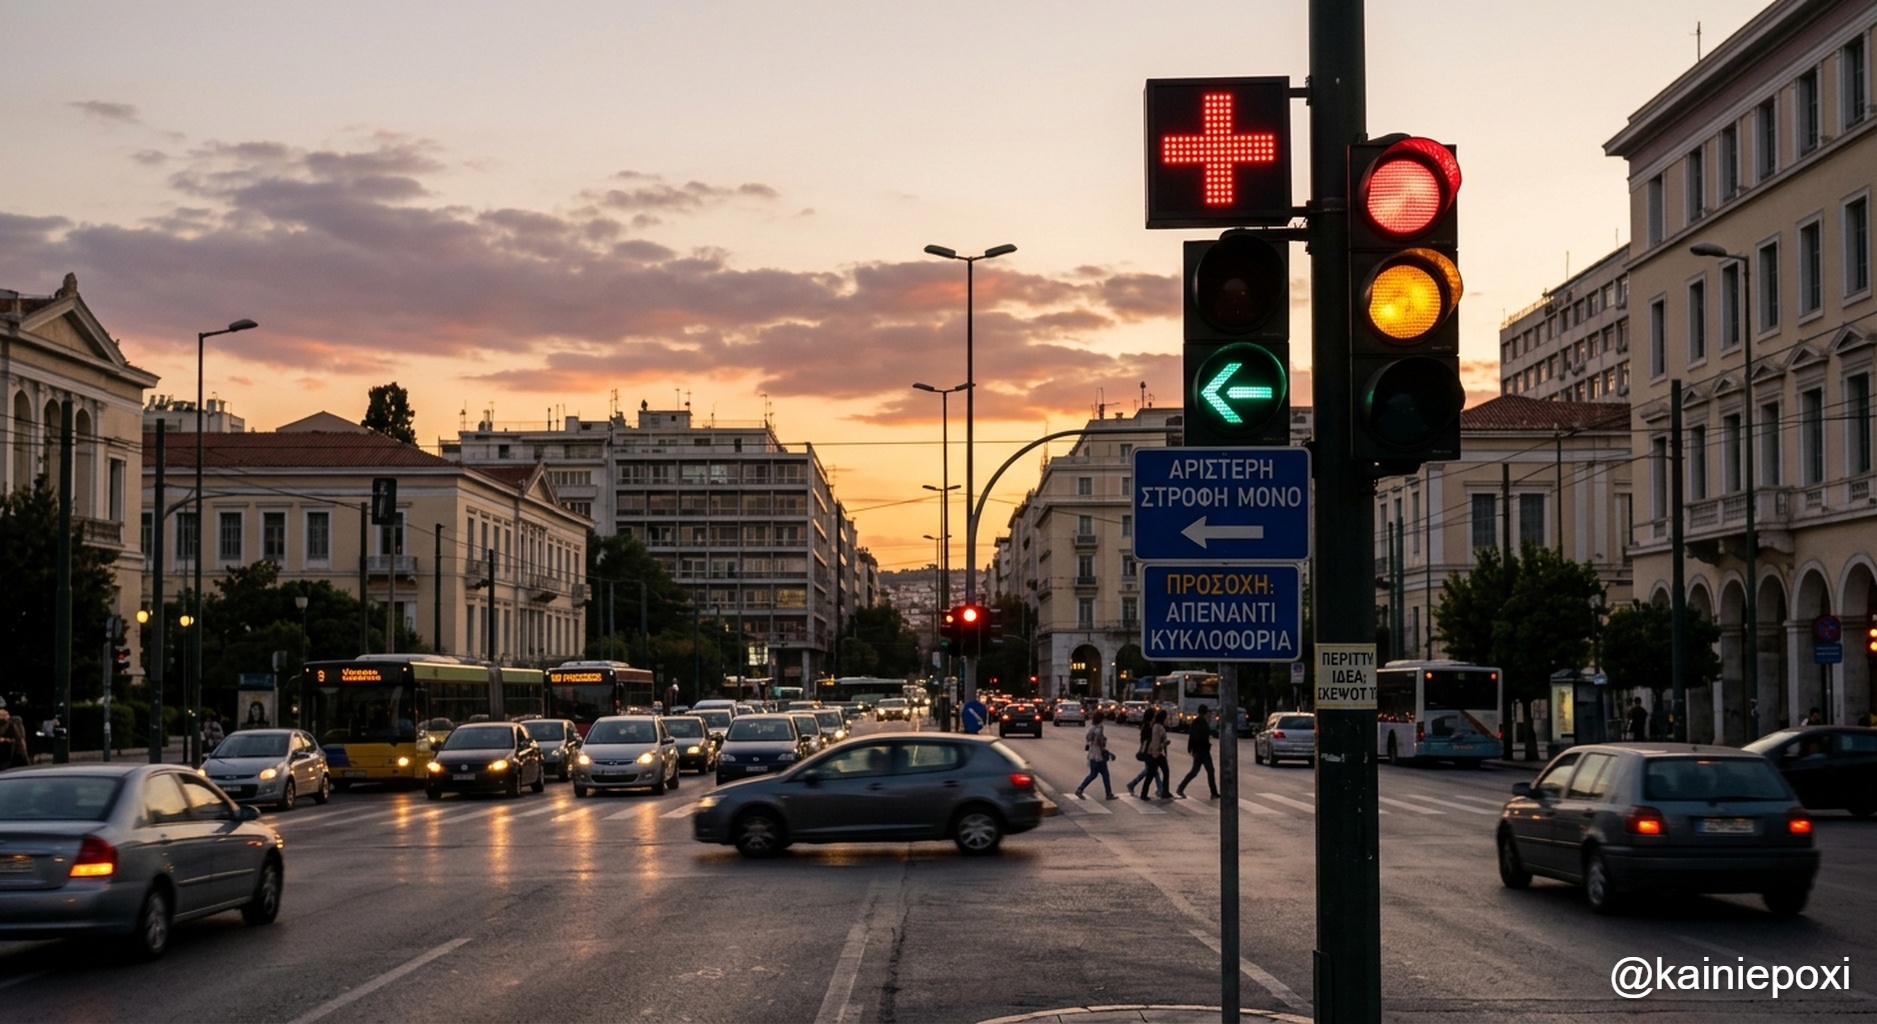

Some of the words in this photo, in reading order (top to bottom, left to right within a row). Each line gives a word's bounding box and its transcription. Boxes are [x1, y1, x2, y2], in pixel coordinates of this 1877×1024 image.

[1169, 459, 1273, 479] ΑΡΙΣΤΕΡΗ
[1141, 487, 1228, 507] ΣΤΡΟΦΗ
[1238, 487, 1301, 507] ΜΟΝΟ
[1166, 574, 1274, 595] ΠΡΟΣΟΧΗ:
[1166, 602, 1275, 623] ΑΠΕΝΑΝΤΙ
[1151, 629, 1292, 651] ΚΥΚΛΟΦΟΡΙΑ
[1332, 670, 1367, 685] ΙΔΕΑ;
